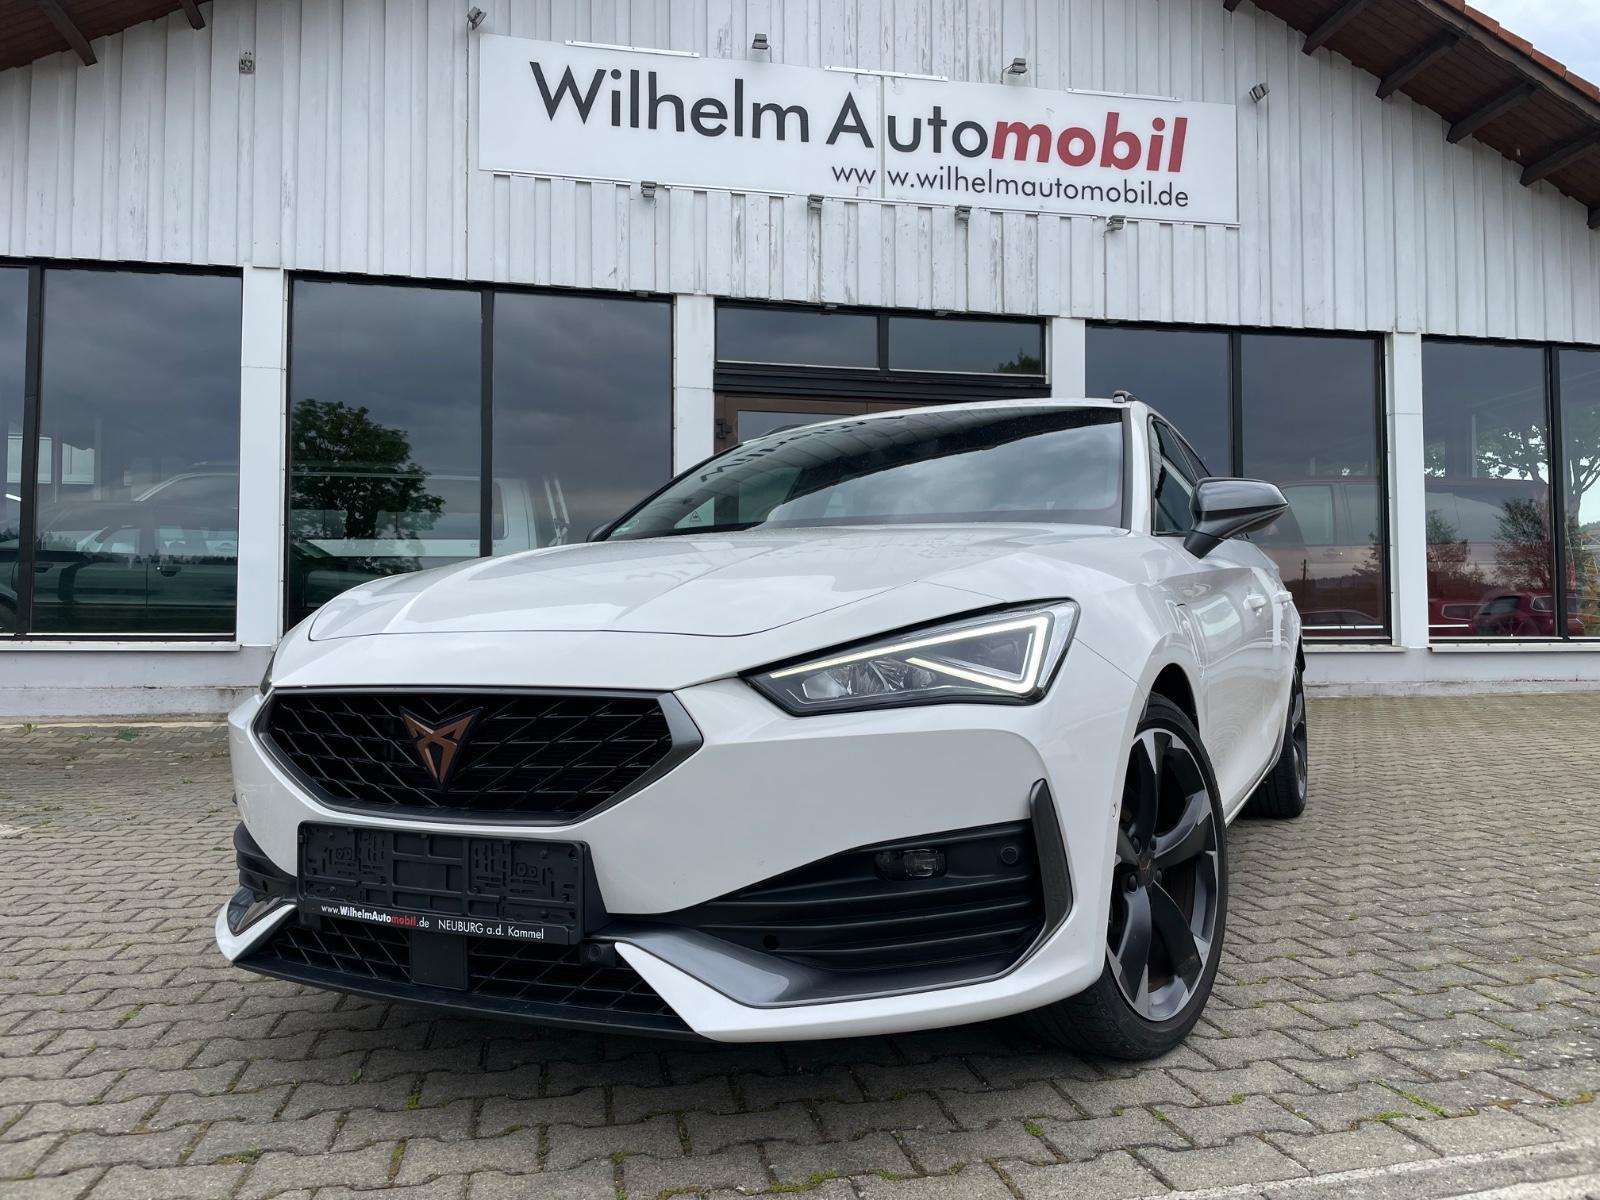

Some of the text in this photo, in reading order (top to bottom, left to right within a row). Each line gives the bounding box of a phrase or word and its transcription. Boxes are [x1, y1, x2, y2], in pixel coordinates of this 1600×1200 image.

[530, 62, 809, 142] Wilhelm
[321, 904, 544, 939] www.WilhelmAutomobil.de NEUBURG a.d. Kammel
